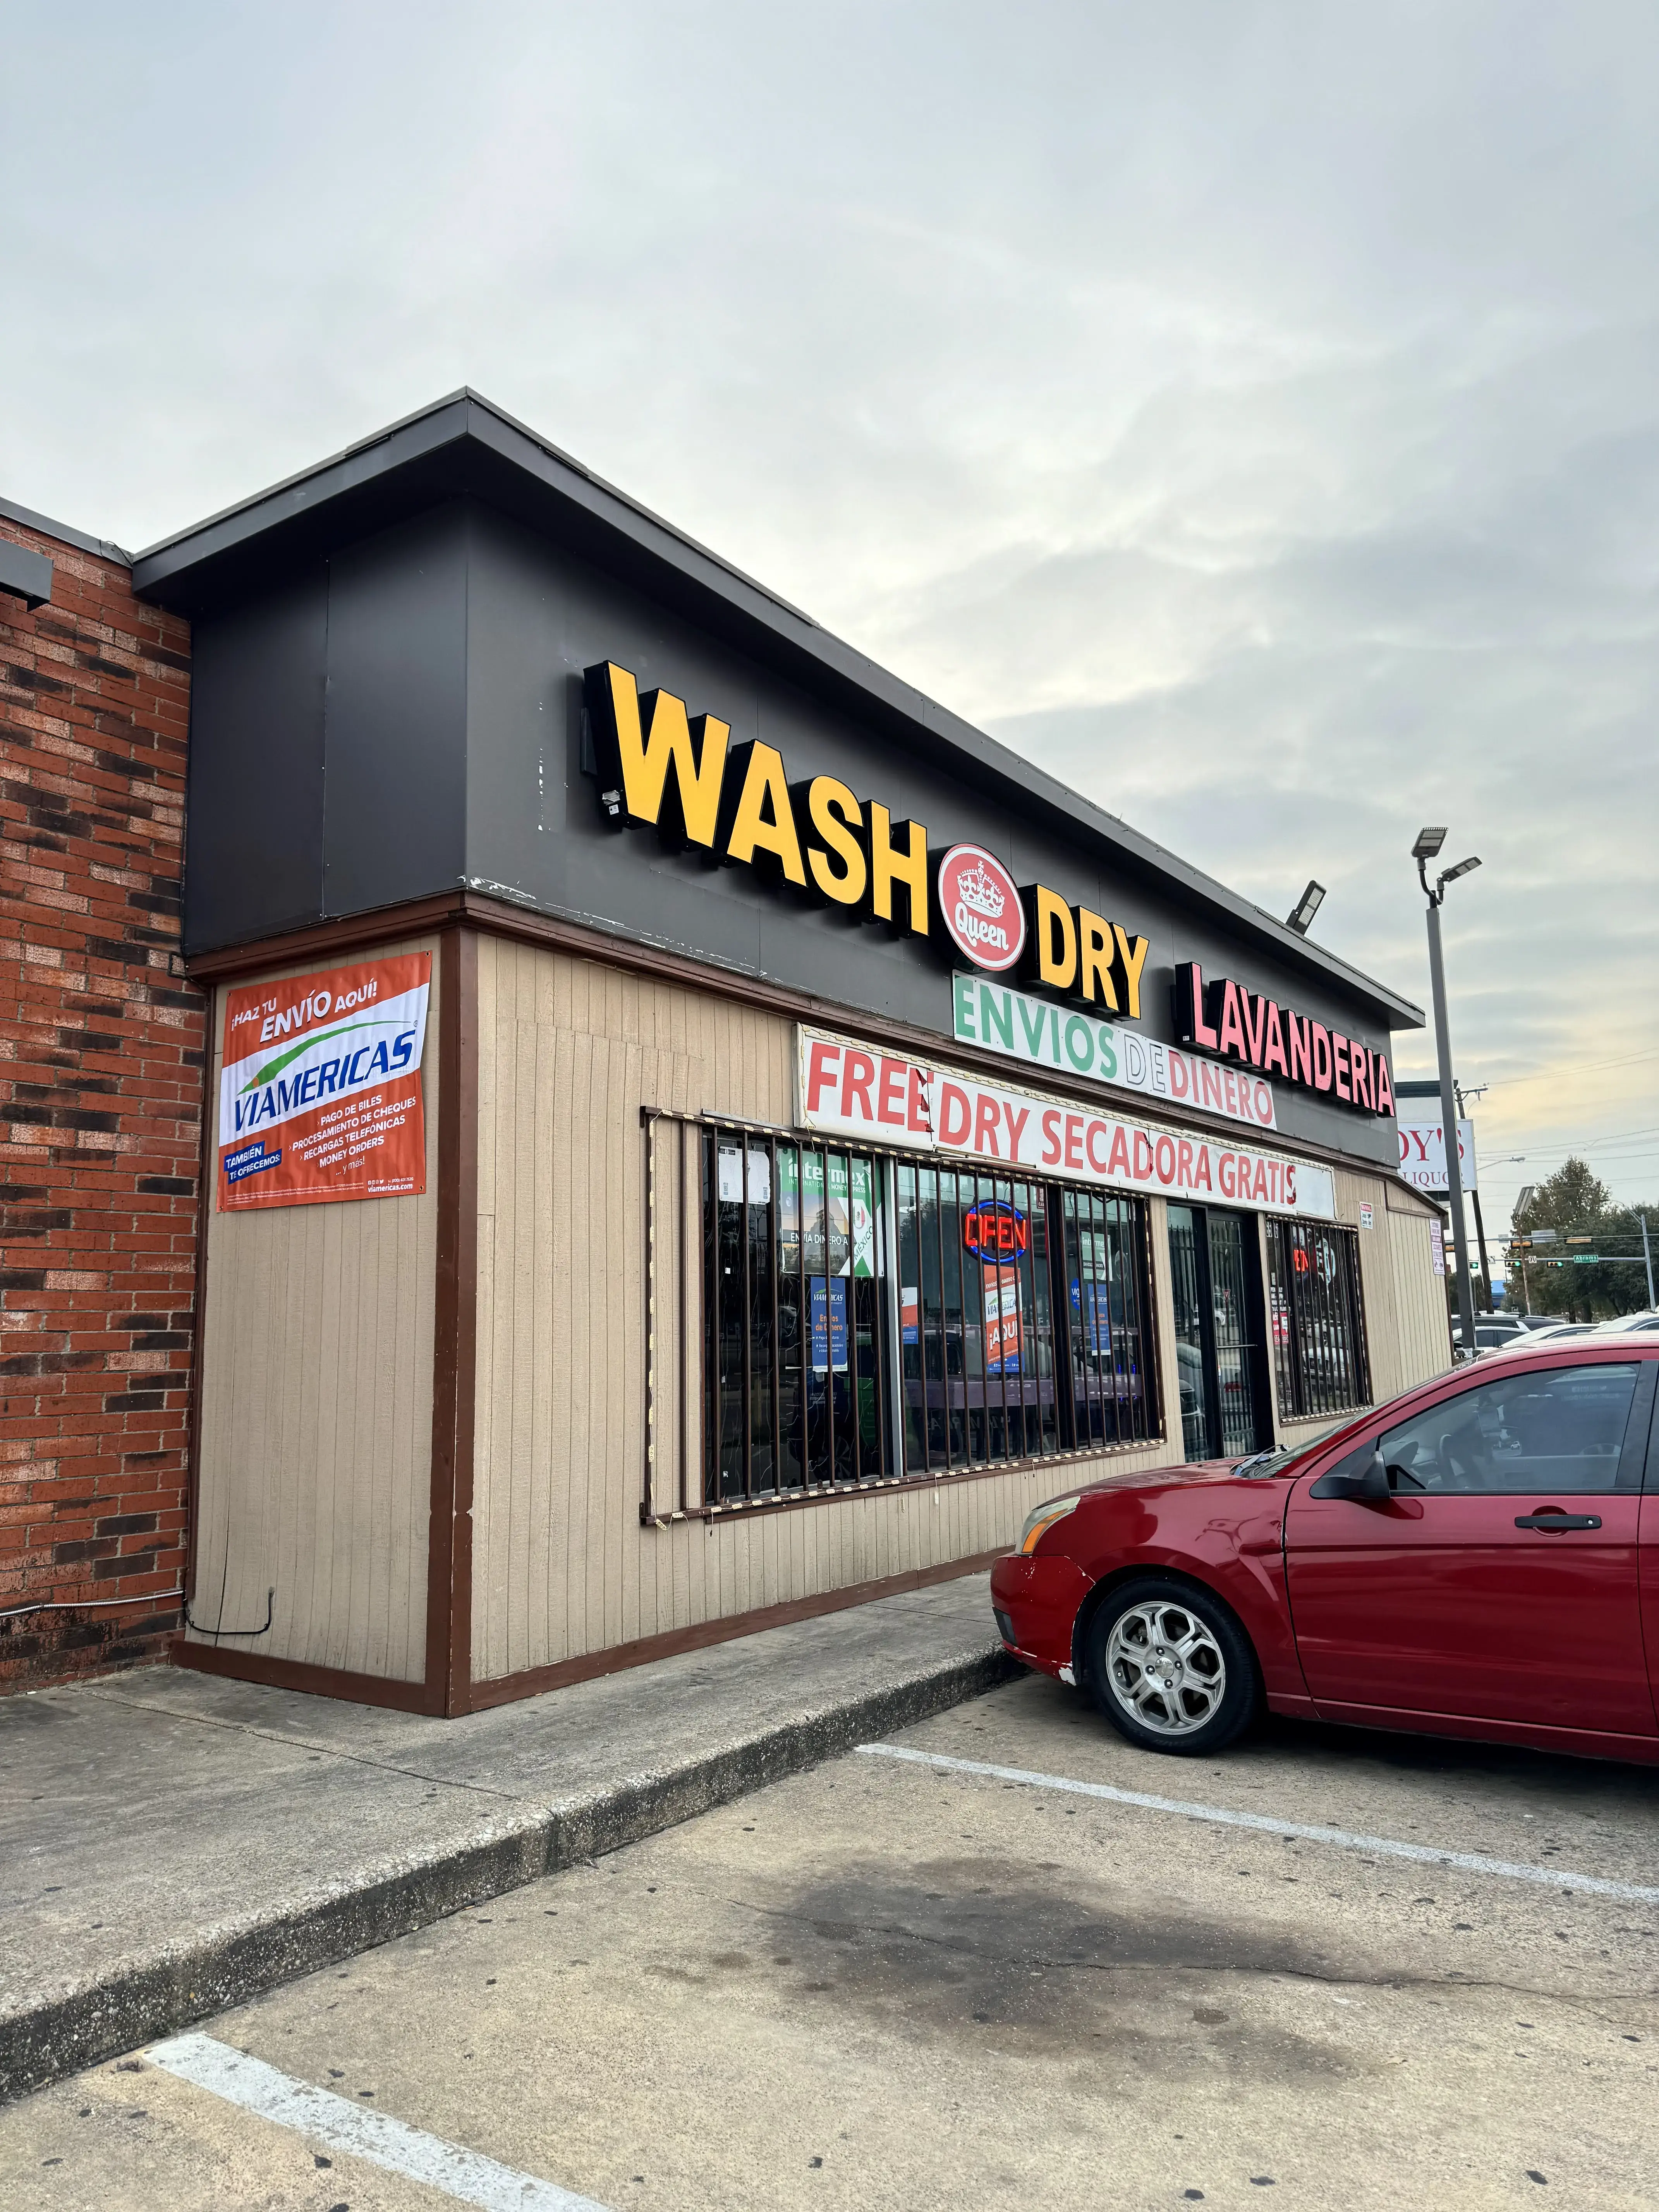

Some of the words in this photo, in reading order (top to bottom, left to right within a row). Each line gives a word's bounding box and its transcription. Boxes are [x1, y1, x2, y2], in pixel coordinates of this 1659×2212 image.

[608, 661, 928, 936] WASH
[1037, 884, 1149, 1019] DRY
[955, 902, 1009, 951] Queen
[262, 997, 276, 1015] TU
[334, 977, 377, 1013] AQUÍ!
[231, 1006, 260, 1031] ¡HAZ
[260, 989, 332, 1043] ENVÍO
[955, 975, 1118, 1079] ENVIOS
[1124, 1034, 1166, 1093] DE
[1168, 1049, 1273, 1125] DINERO
[1192, 962, 1395, 1117] LAVANDERIA
[235, 1029, 416, 1132] VIAMERICAS
[292, 1119, 359, 1151] PROCESAMIENTO
[361, 1113, 372, 1124] DE
[373, 1096, 416, 1119] CHEQUES
[320, 1110, 343, 1126] PAGO
[345, 1104, 356, 1116] DE
[359, 1095, 382, 1111] BILES
[807, 1042, 934, 1132] FREE
[939, 1081, 1030, 1162] DRY
[1042, 1109, 1212, 1191] SECADORA
[1218, 1153, 1297, 1205] GRATIS
[304, 1139, 344, 1161] RECARGAS
[345, 1115, 405, 1143] TELEFÓNICAS
[319, 1150, 347, 1168] MONEY
[349, 1135, 384, 1156] ORDERS
[226, 1145, 262, 1169] TAMBIÉN
[230, 1171, 237, 1180] TE
[237, 1154, 280, 1176] OFRECEMOS:
[343, 1164, 347, 1175] y
[348, 1156, 365, 1170] más!
[368, 1183, 413, 1193] viamericas.com
[843, 1237, 848, 1246] A
[965, 1213, 1026, 1250] OPEN
